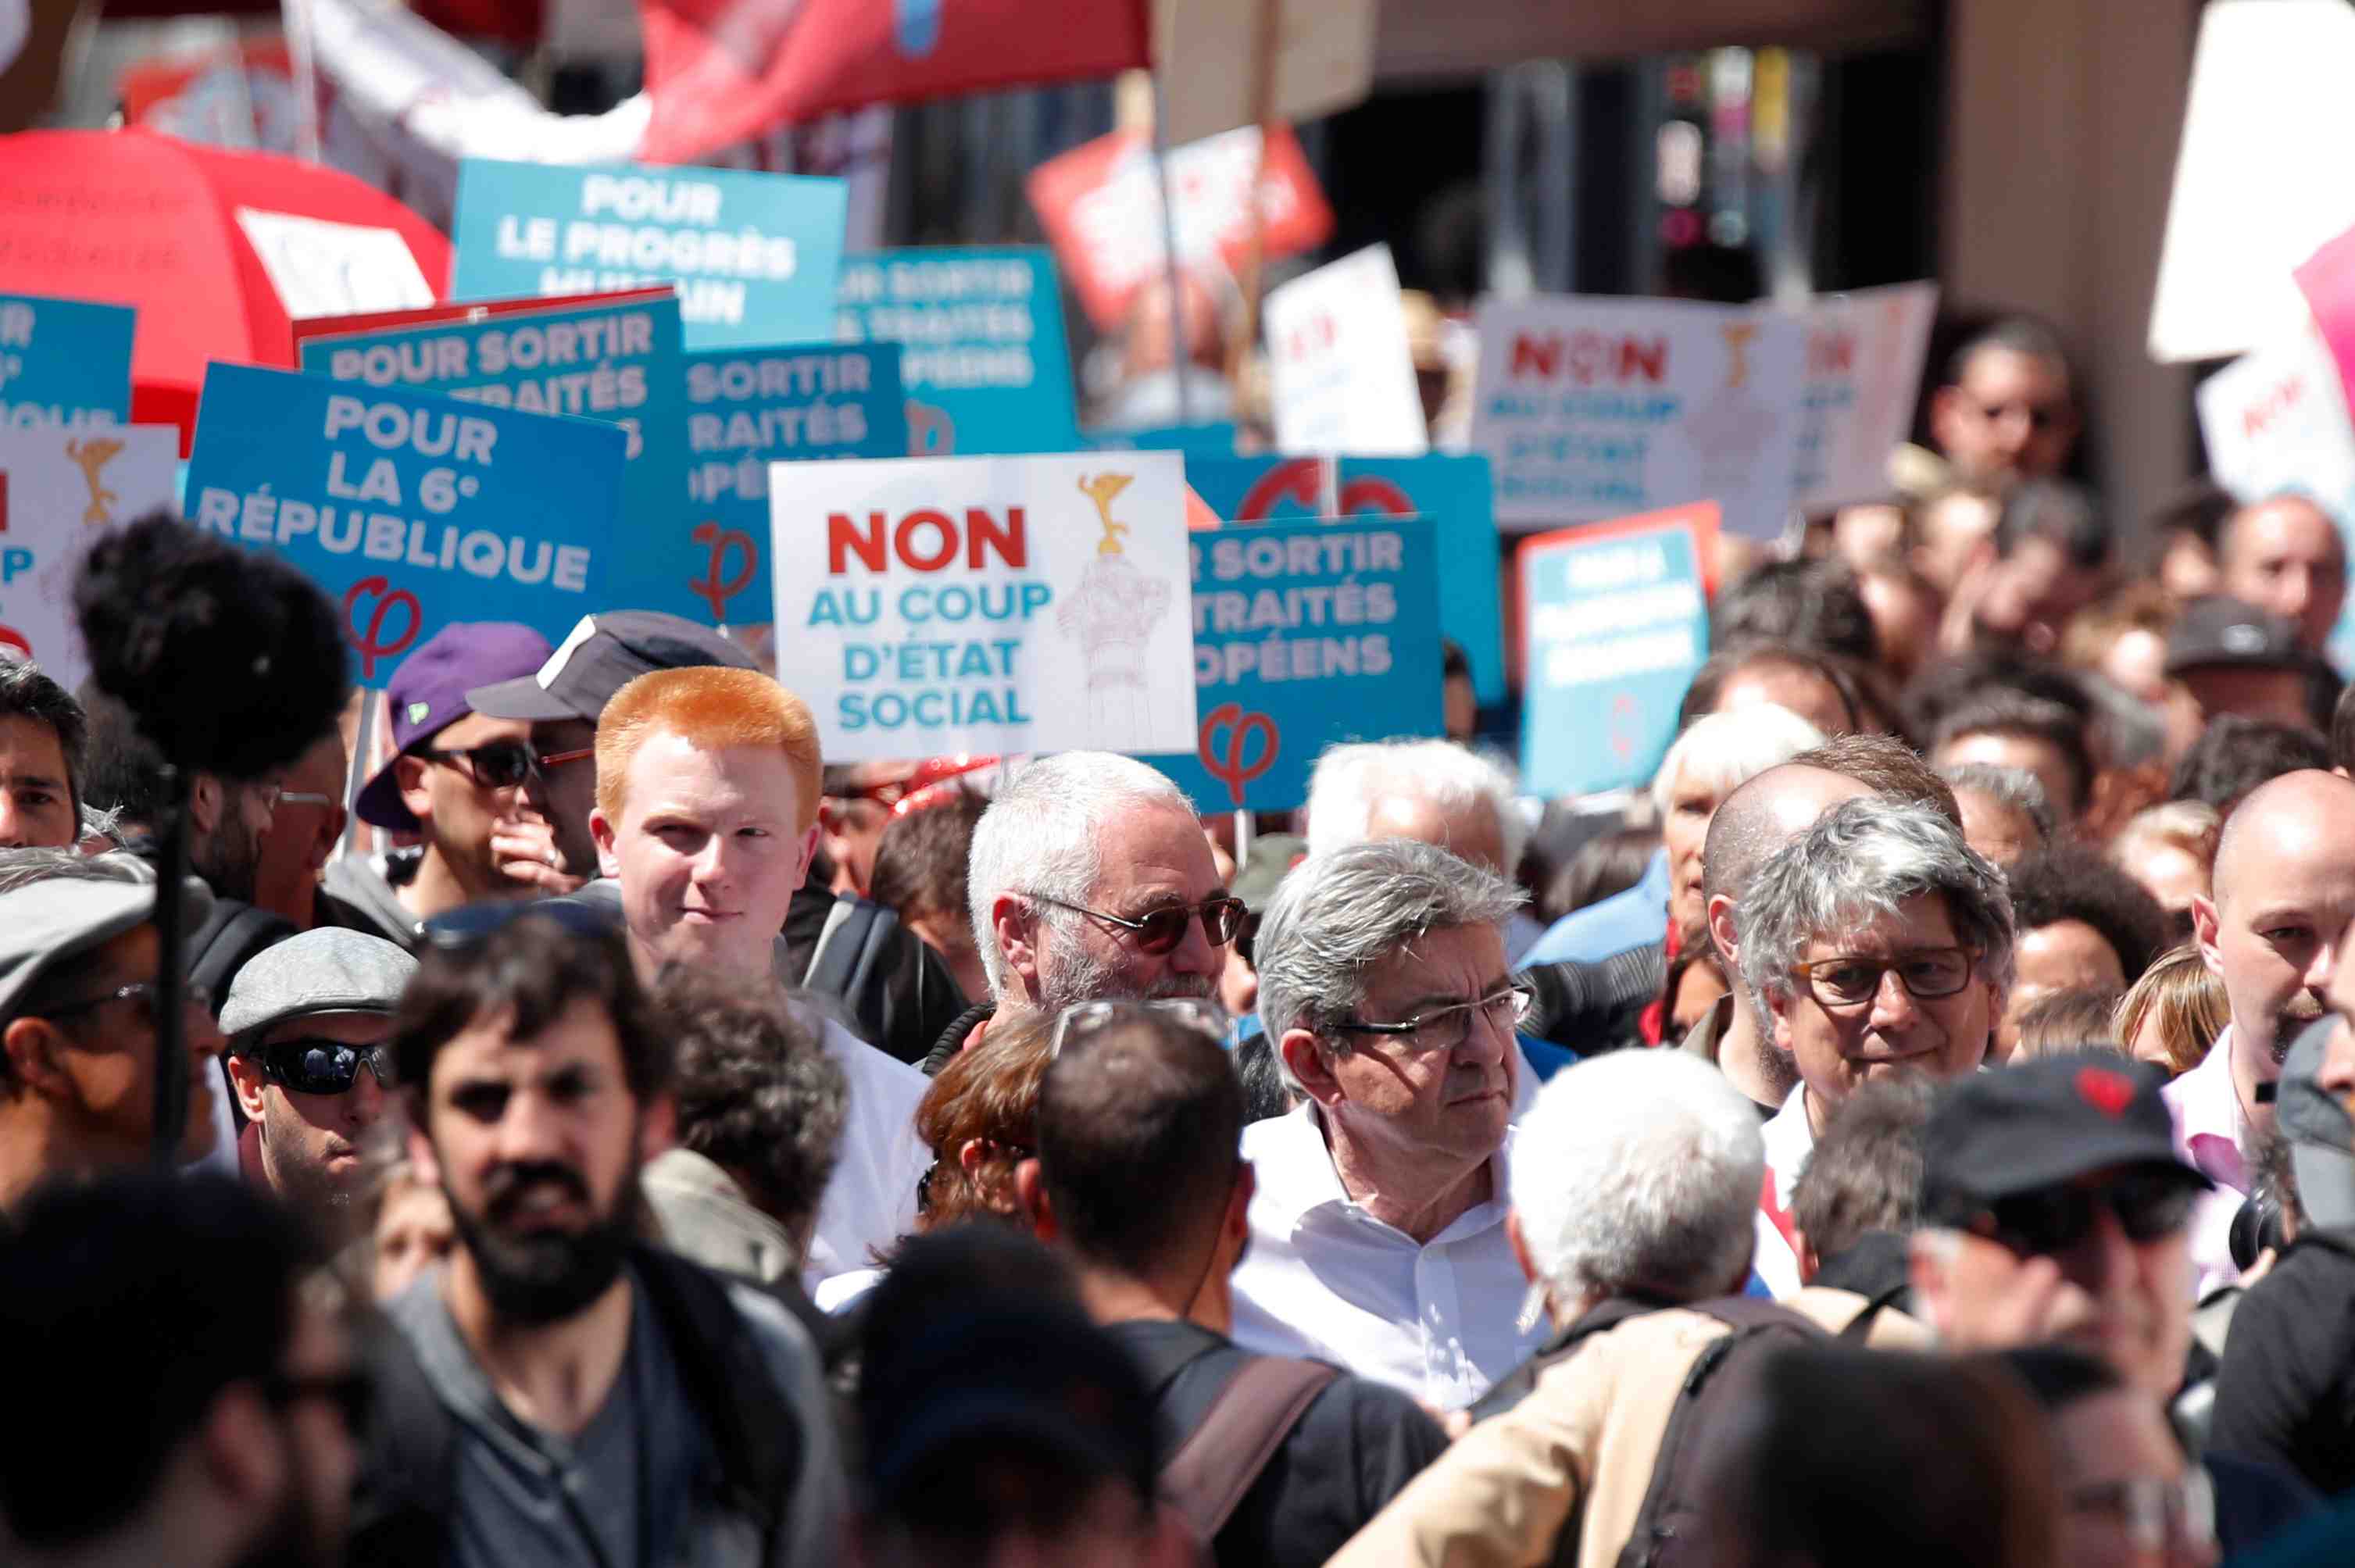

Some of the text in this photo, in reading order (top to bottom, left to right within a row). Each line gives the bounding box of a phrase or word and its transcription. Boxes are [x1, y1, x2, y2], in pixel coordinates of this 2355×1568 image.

[580, 173, 722, 226] POUR
[501, 213, 796, 282] LE PROGRÈS
[331, 312, 654, 387] POUR SORTIR
[686, 352, 871, 404] SORTIR
[323, 395, 498, 466] POUR
[327, 451, 402, 506] LA
[198, 482, 591, 594] RÉPUBLIQUE
[827, 507, 1027, 574] NON
[1212, 531, 1403, 580] SORTIR
[807, 582, 1053, 626] AU COUP
[1192, 573, 1397, 634] TRAITÉS
[843, 630, 1022, 680] D'ÉTAT
[1195, 630, 1392, 685] OPÉENS
[838, 687, 1033, 730] SOCIAL
